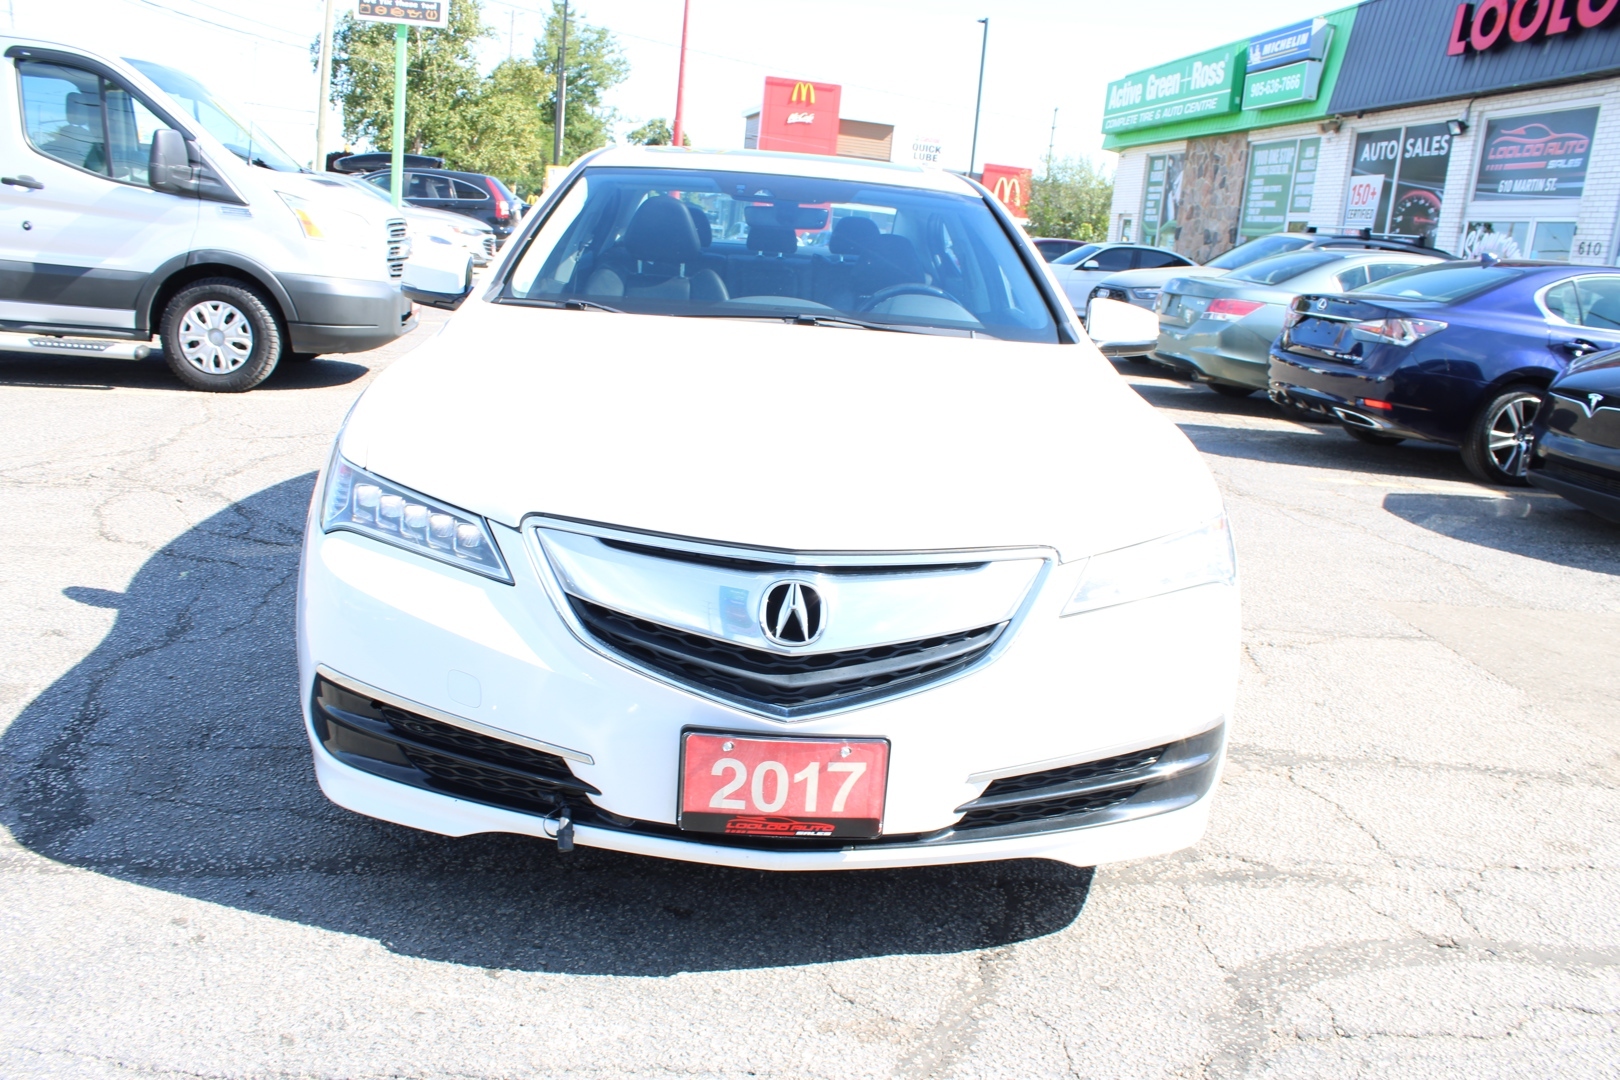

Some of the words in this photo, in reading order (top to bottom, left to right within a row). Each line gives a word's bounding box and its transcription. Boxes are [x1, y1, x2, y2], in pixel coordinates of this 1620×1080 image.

[1262, 33, 1309, 55] MICHELIN
[1108, 82, 1142, 109] Active
[1251, 75, 1301, 96] 905-636-7666
[1106, 113, 1138, 129] COMPLETE
[1140, 110, 1154, 123] TIRE
[1163, 106, 1182, 118] AUTO
[1184, 99, 1217, 113] CENTRE
[912, 143, 942, 154] QUICK
[913, 153, 938, 162] LUBE
[1361, 141, 1397, 161] AUTO
[1404, 134, 1450, 158] SALES
[1488, 143, 1544, 160] LOOLOO
[1544, 139, 1589, 156] AUTO
[1546, 158, 1583, 169] SALES
[1351, 184, 1377, 205] 150+
[1498, 180, 1512, 193] 610
[1513, 178, 1544, 193] MARTIN
[1544, 178, 1556, 191] ST.
[1347, 209, 1374, 220] CERTIFIED
[1578, 241, 1601, 256] 610
[708, 757, 867, 813] 2017
[725, 822, 790, 831] LOOLOO
[790, 823, 836, 832] AUTO
